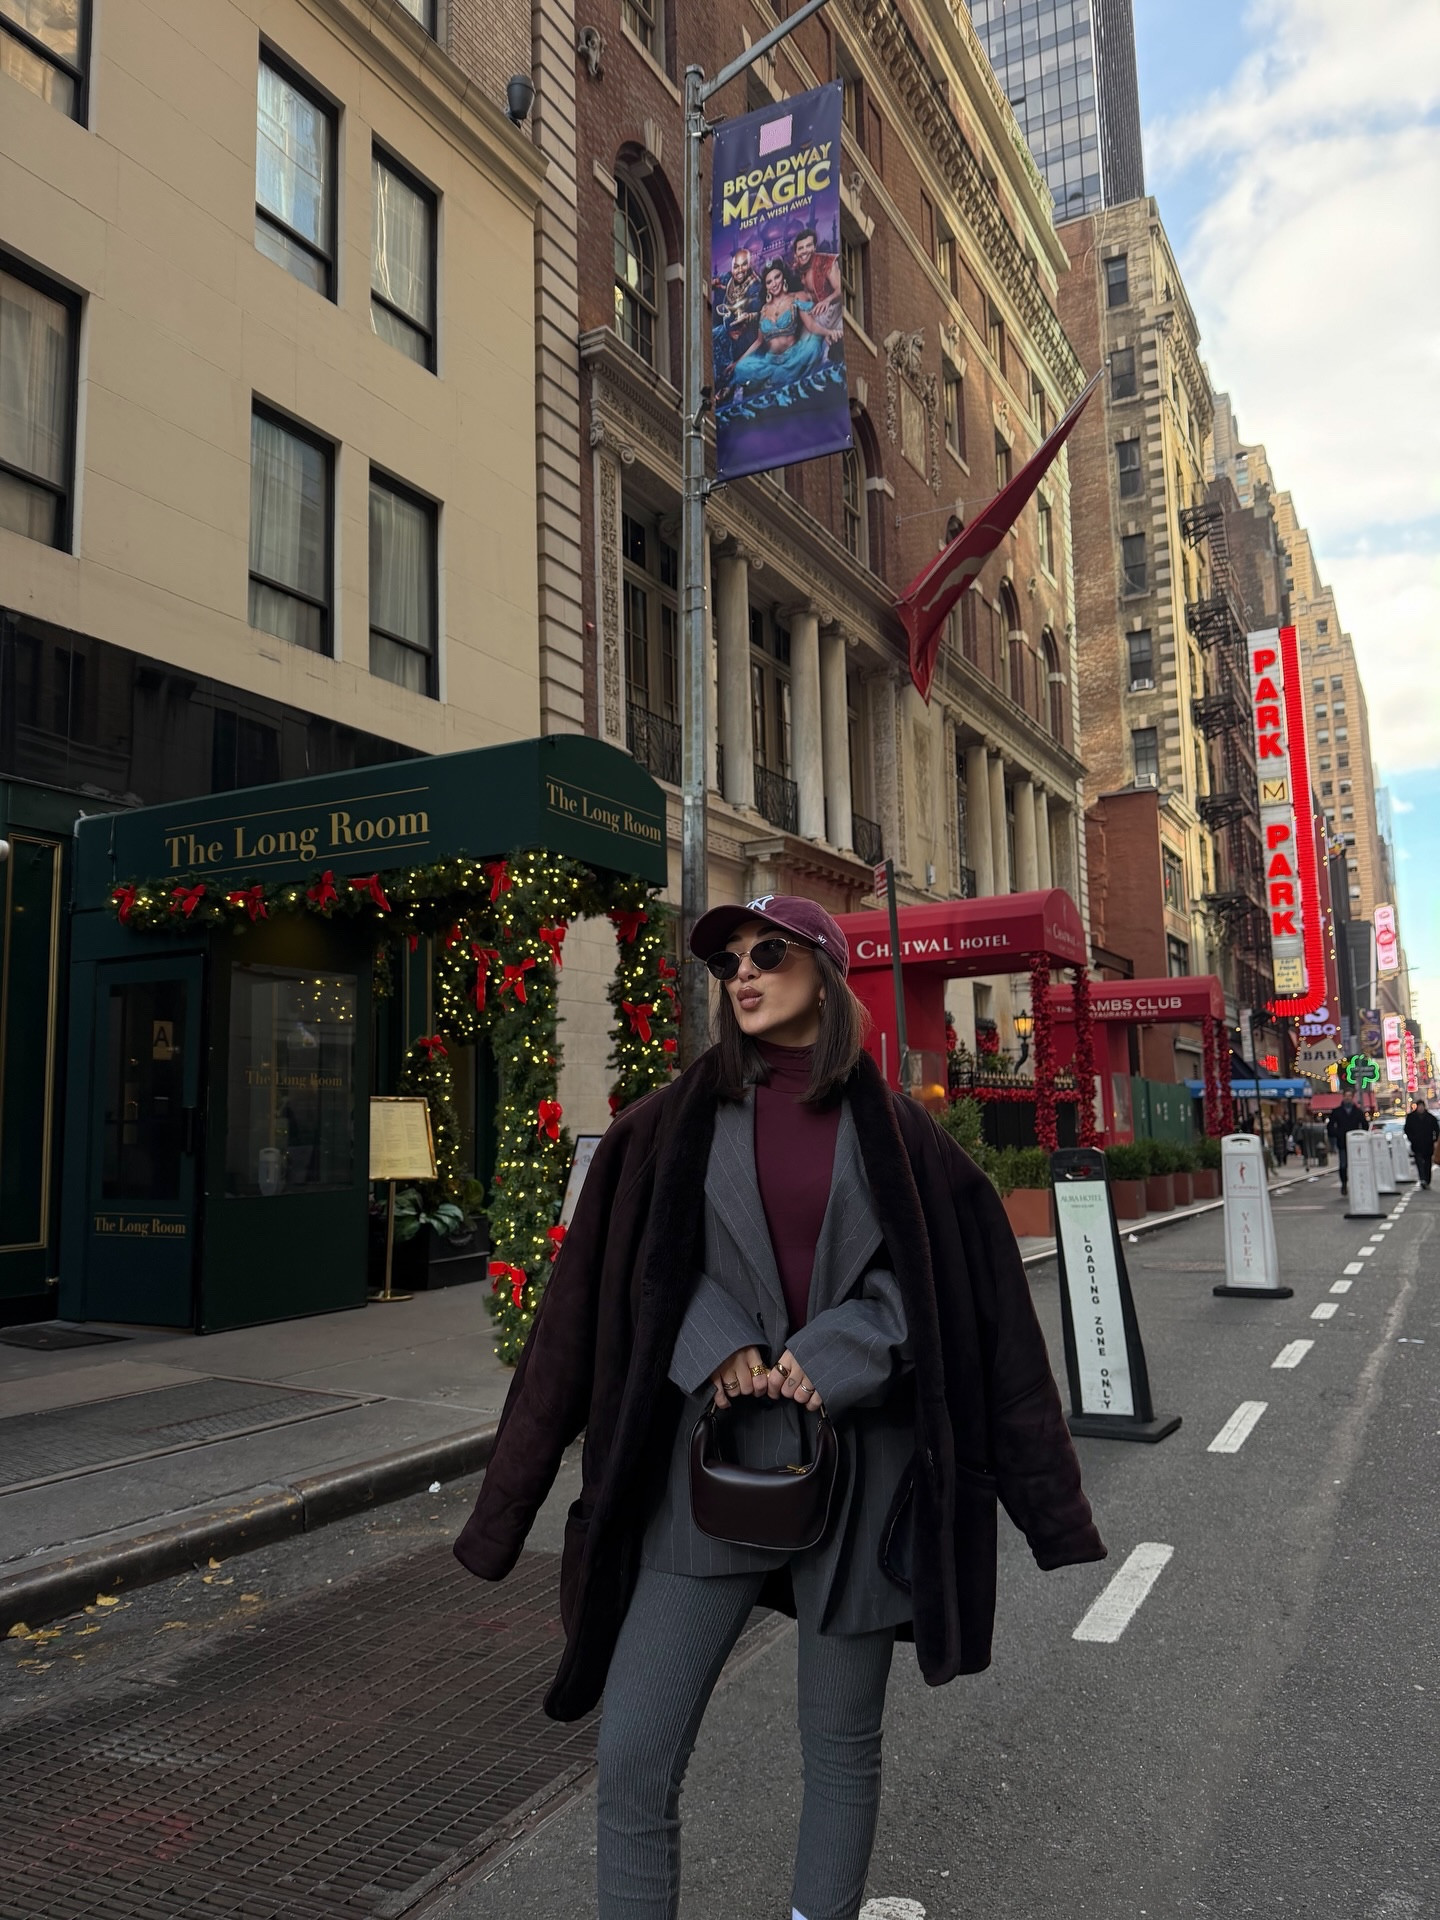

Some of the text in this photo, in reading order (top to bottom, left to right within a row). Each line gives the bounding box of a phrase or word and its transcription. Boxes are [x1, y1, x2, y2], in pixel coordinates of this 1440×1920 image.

[723, 141, 832, 198] BROADWAY
[723, 160, 831, 227] MAGIC
[739, 195, 813, 230] JUST A WISH AWAY
[1253, 648, 1284, 759] PARK
[546, 782, 661, 841] The Long Room
[165, 811, 430, 868] The Long Room
[1265, 823, 1297, 937] PARK
[856, 934, 1010, 959] CHTWAL HOTEL
[1088, 998, 1133, 1011] AMBS
[1136, 996, 1182, 1010] CLUB
[1089, 1010, 1131, 1018] STAURANT
[154, 1026, 170, 1047] A
[1299, 1023, 1336, 1036] BBQ
[1304, 1051, 1337, 1060] BAR
[245, 1070, 343, 1088] The Long Room
[94, 1216, 186, 1237] The Long Room
[1241, 1211, 1252, 1267] VALET
[1084, 1235, 1100, 1305] LOADING
[1095, 1316, 1107, 1357] ZONE
[1101, 1368, 1111, 1410] ONLY
